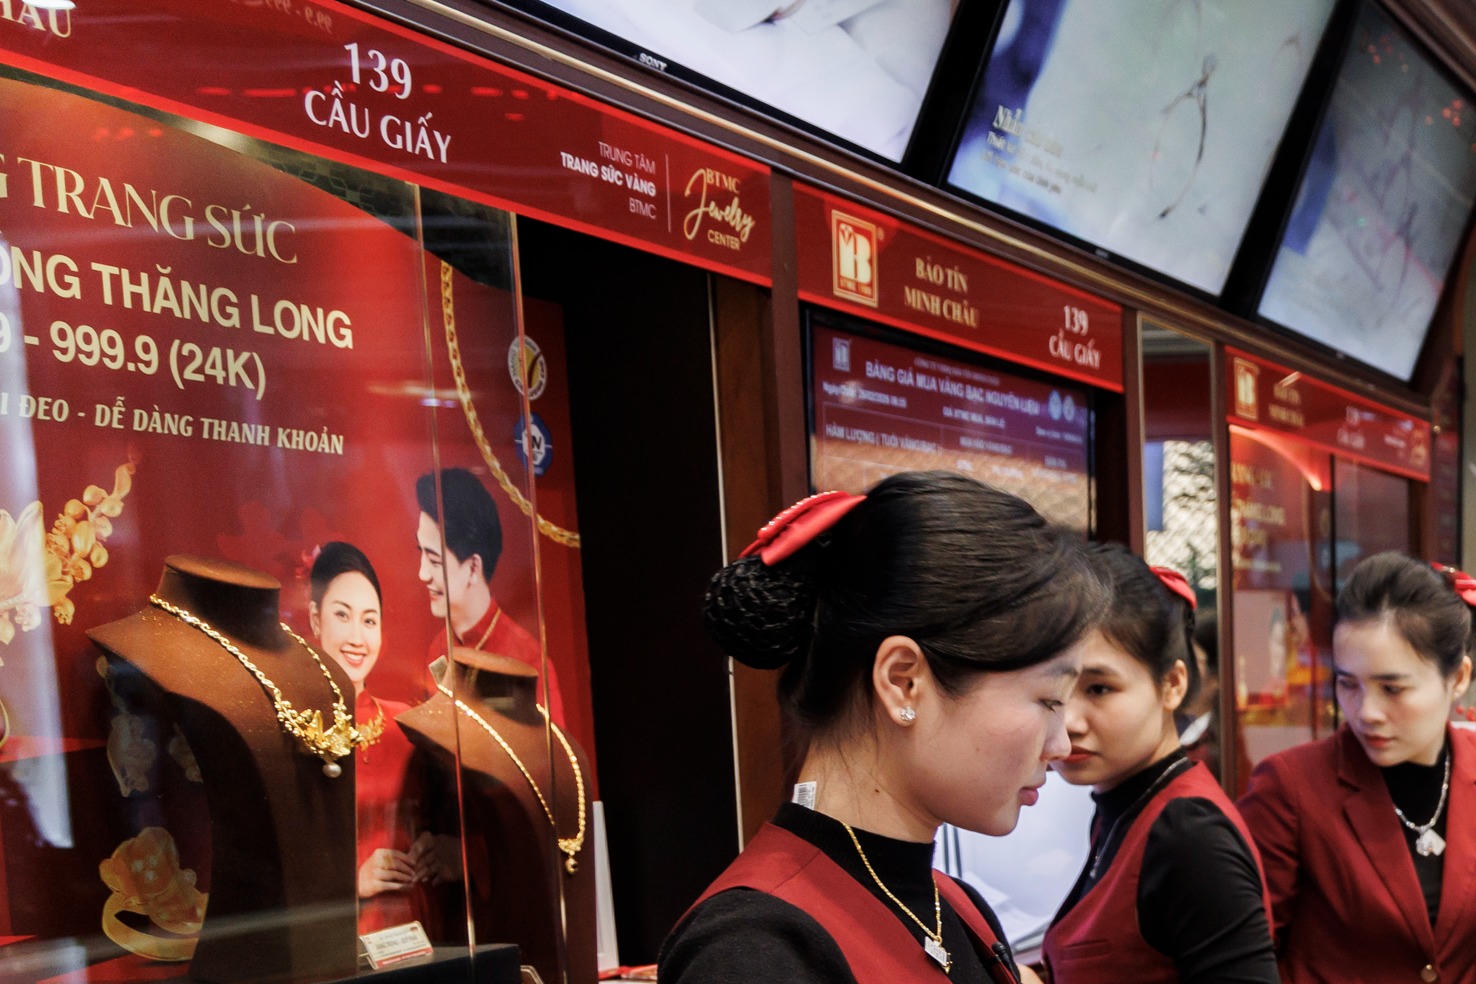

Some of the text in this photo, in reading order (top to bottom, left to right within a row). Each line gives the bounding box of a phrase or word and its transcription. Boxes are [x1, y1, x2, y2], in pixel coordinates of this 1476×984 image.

[343, 42, 412, 100] 139
[640, 52, 668, 71] SONY
[304, 80, 451, 164] CẦU GIẤY
[560, 151, 599, 178] TRANG
[625, 173, 656, 197] VÀNG
[598, 141, 656, 175] TRUNG TÂM
[706, 167, 741, 194] BTMC
[16, 156, 195, 242] TRANG
[204, 203, 298, 265] SỨC
[629, 197, 656, 220] BTMC
[684, 167, 755, 243] Jewelry
[707, 229, 741, 251] CENTER
[945, 264, 969, 293] TÍN
[90, 261, 241, 329] THĂNG
[250, 293, 354, 349] LONG
[904, 285, 941, 316] MINH
[942, 298, 979, 328] CHÂU
[1063, 305, 1089, 336] 139
[50, 320, 160, 376] 999.9
[169, 338, 266, 401] (24K)
[1049, 328, 1072, 362] CẦU
[897, 365, 914, 387] GIÁ
[95, 395, 126, 430] DỄ
[133, 403, 194, 438] DÀNG
[200, 416, 271, 448] THANH
[277, 425, 345, 456] KHOẢN
